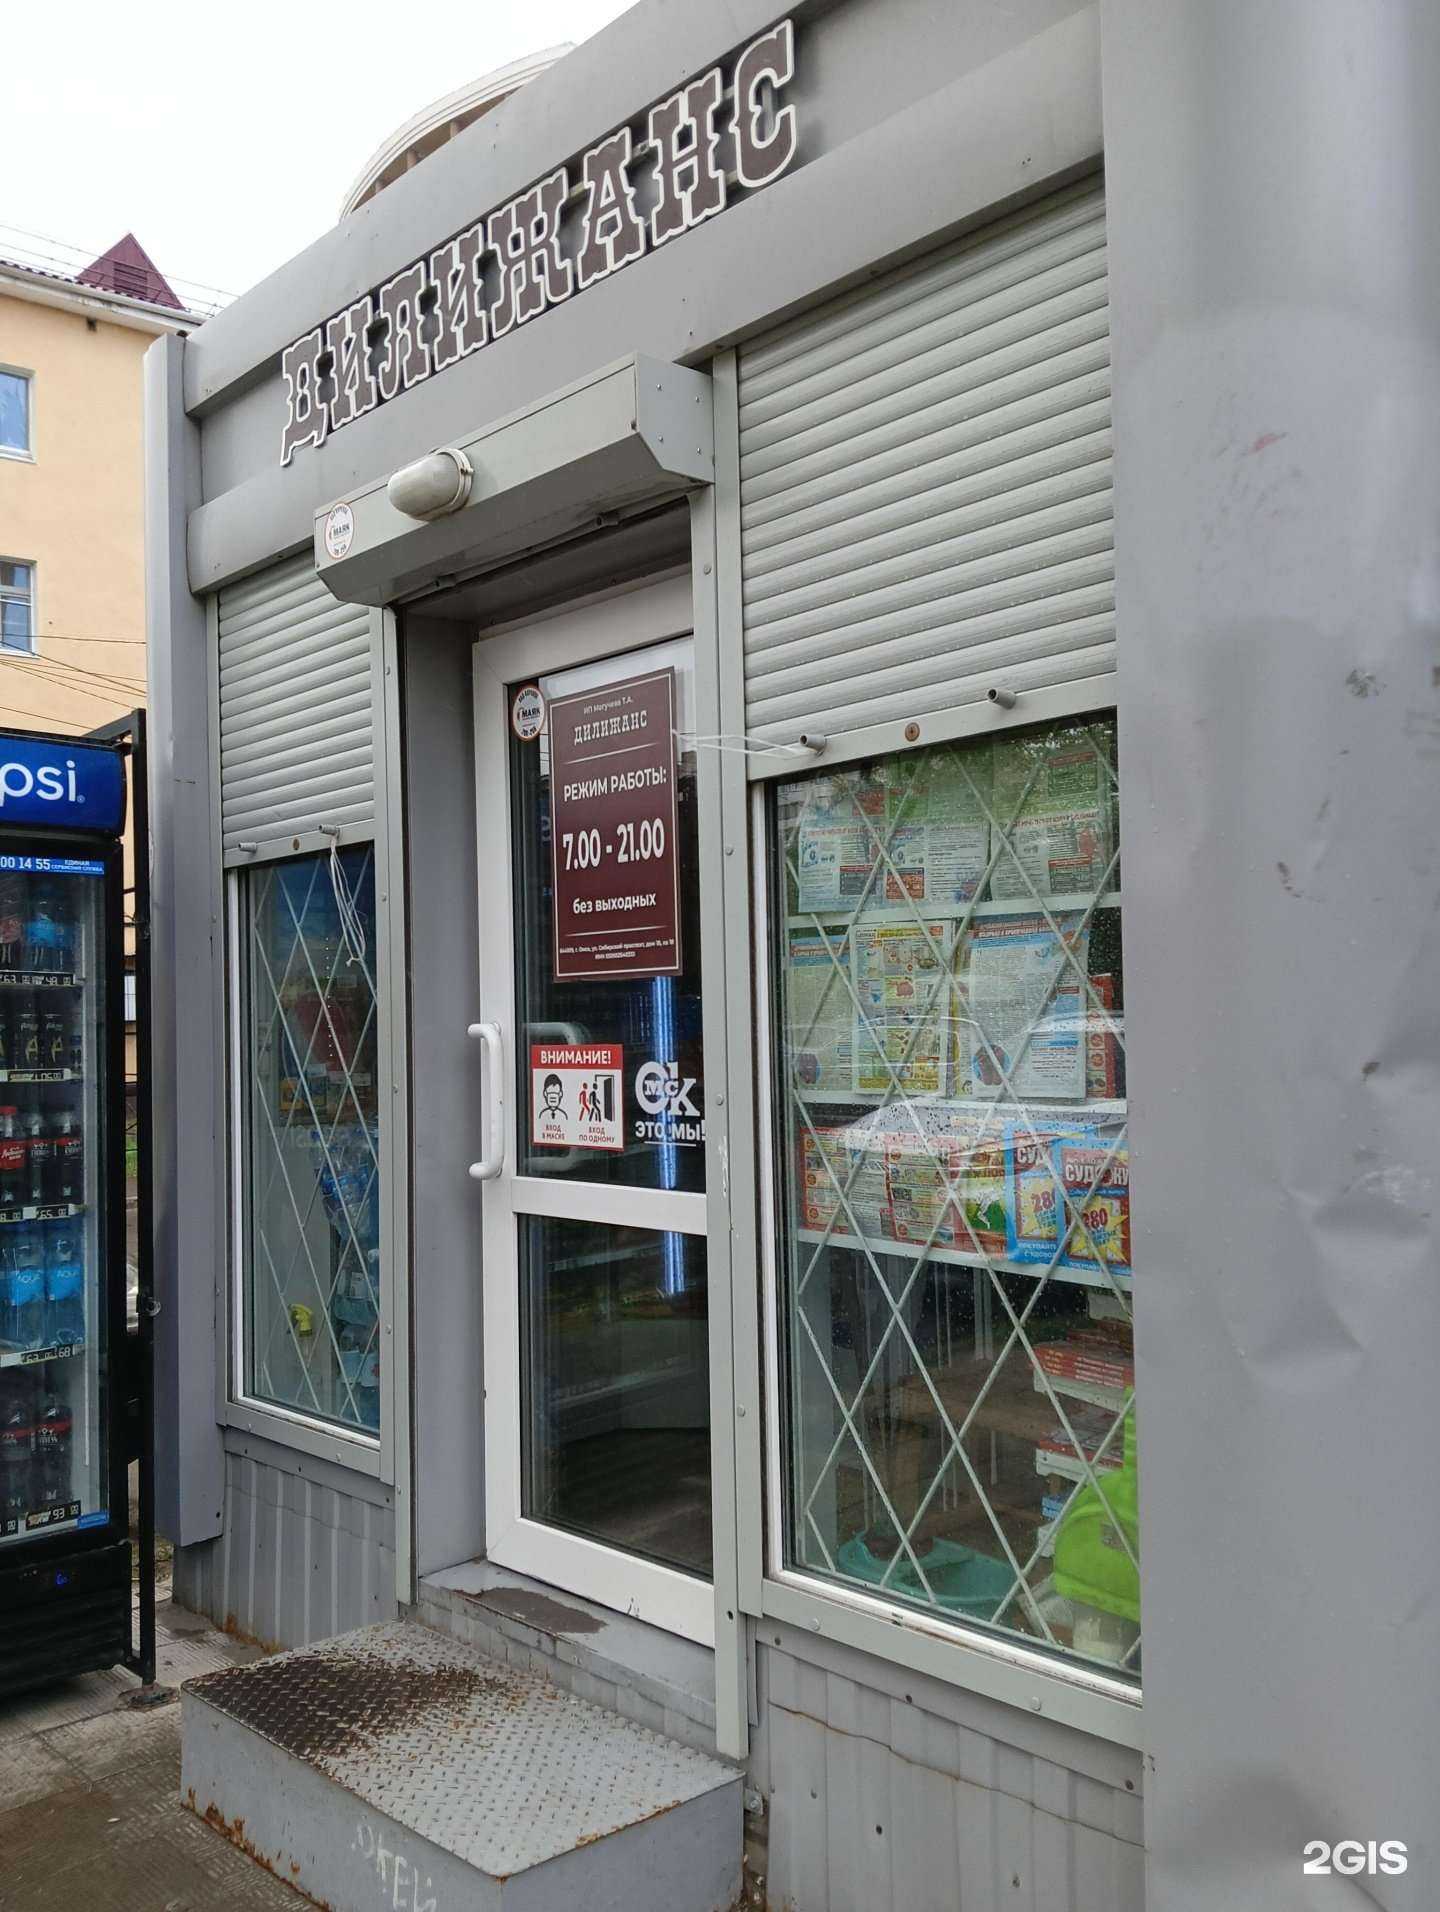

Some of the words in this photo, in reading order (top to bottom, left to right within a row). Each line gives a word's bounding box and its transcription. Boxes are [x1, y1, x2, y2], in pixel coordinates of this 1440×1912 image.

[280, 19, 797, 466] ДИЛИЖАНС
[574, 710, 648, 746] ДИЛИЖАНС
[564, 776, 608, 802] РЕЖИМ
[611, 766, 667, 794] РАБОТЫ:
[562, 828, 601, 871] 7.00
[616, 818, 665, 864] 21.00
[36, 858, 51, 870] 55
[573, 898, 592, 914] без
[595, 893, 657, 912] выходных
[540, 1050, 612, 1065] ВНИМАНИЕ!
[635, 1121, 665, 1138] ЭТО
